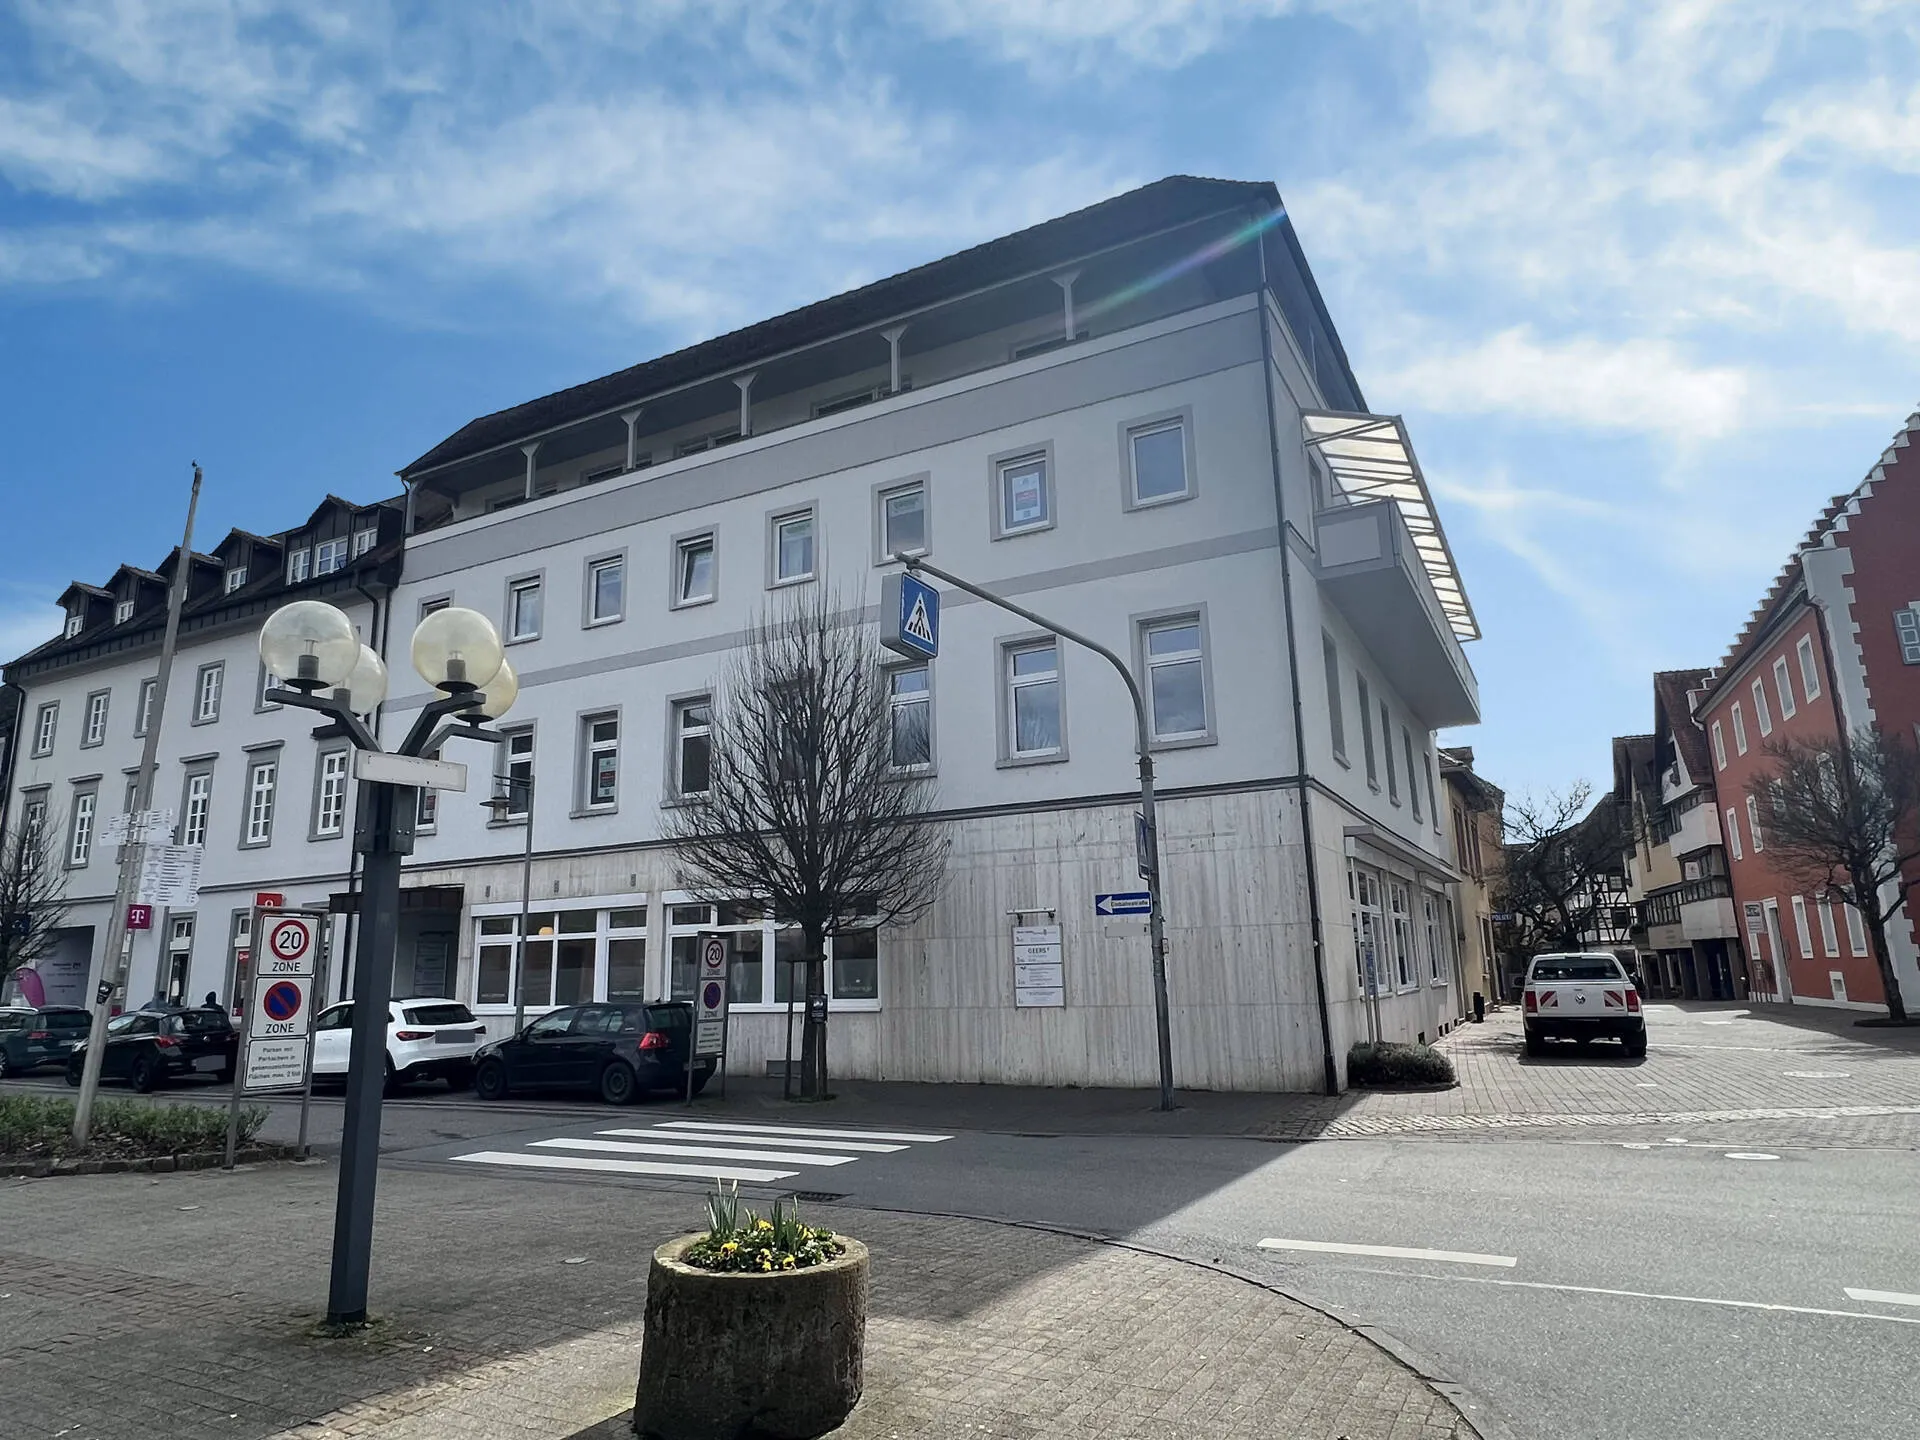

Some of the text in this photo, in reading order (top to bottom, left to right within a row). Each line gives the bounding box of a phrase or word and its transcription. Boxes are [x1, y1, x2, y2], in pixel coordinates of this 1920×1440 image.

[131, 909, 145, 924] T
[279, 930, 302, 950] 20
[709, 947, 721, 961] 20
[272, 961, 301, 972] ZONE
[706, 968, 721, 976] ZONE
[265, 1023, 295, 1034] ZONE
